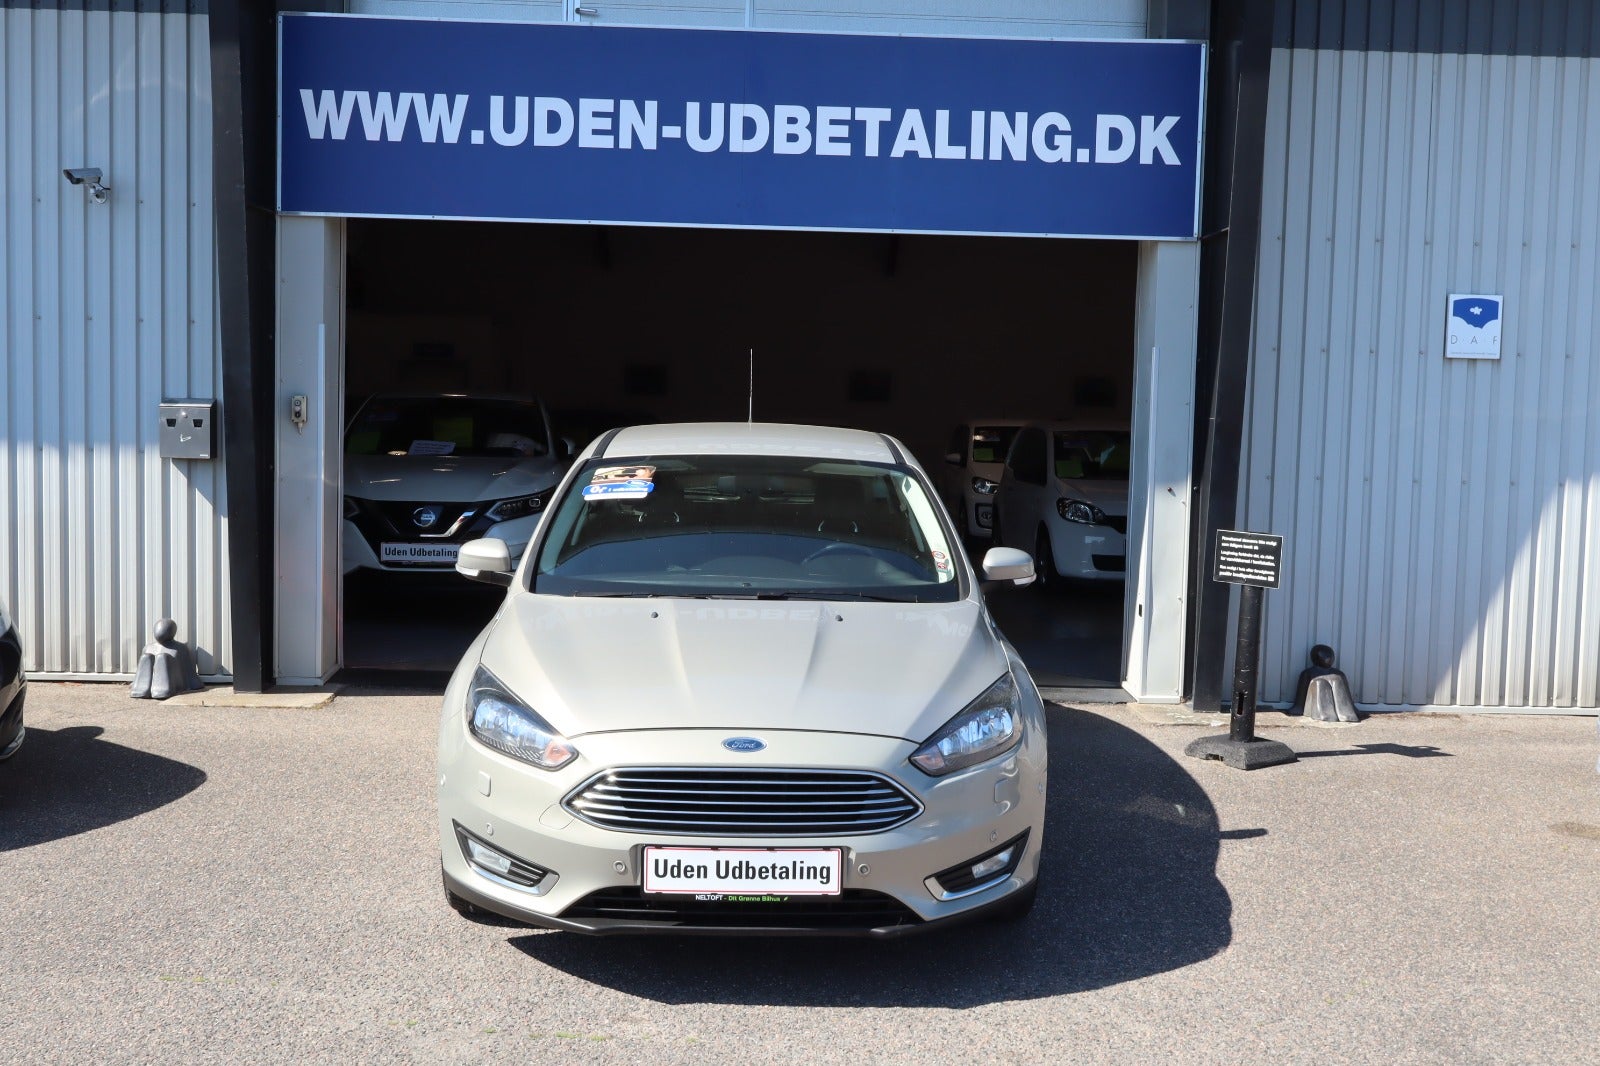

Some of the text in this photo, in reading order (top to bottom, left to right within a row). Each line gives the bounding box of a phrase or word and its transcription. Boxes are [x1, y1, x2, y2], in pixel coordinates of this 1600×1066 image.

[299, 88, 1182, 166] WWW.UDEN-UDBETALING.DK
[384, 547, 458, 558] Uden Udbetaling
[653, 858, 831, 885] Uden Udbetaling
